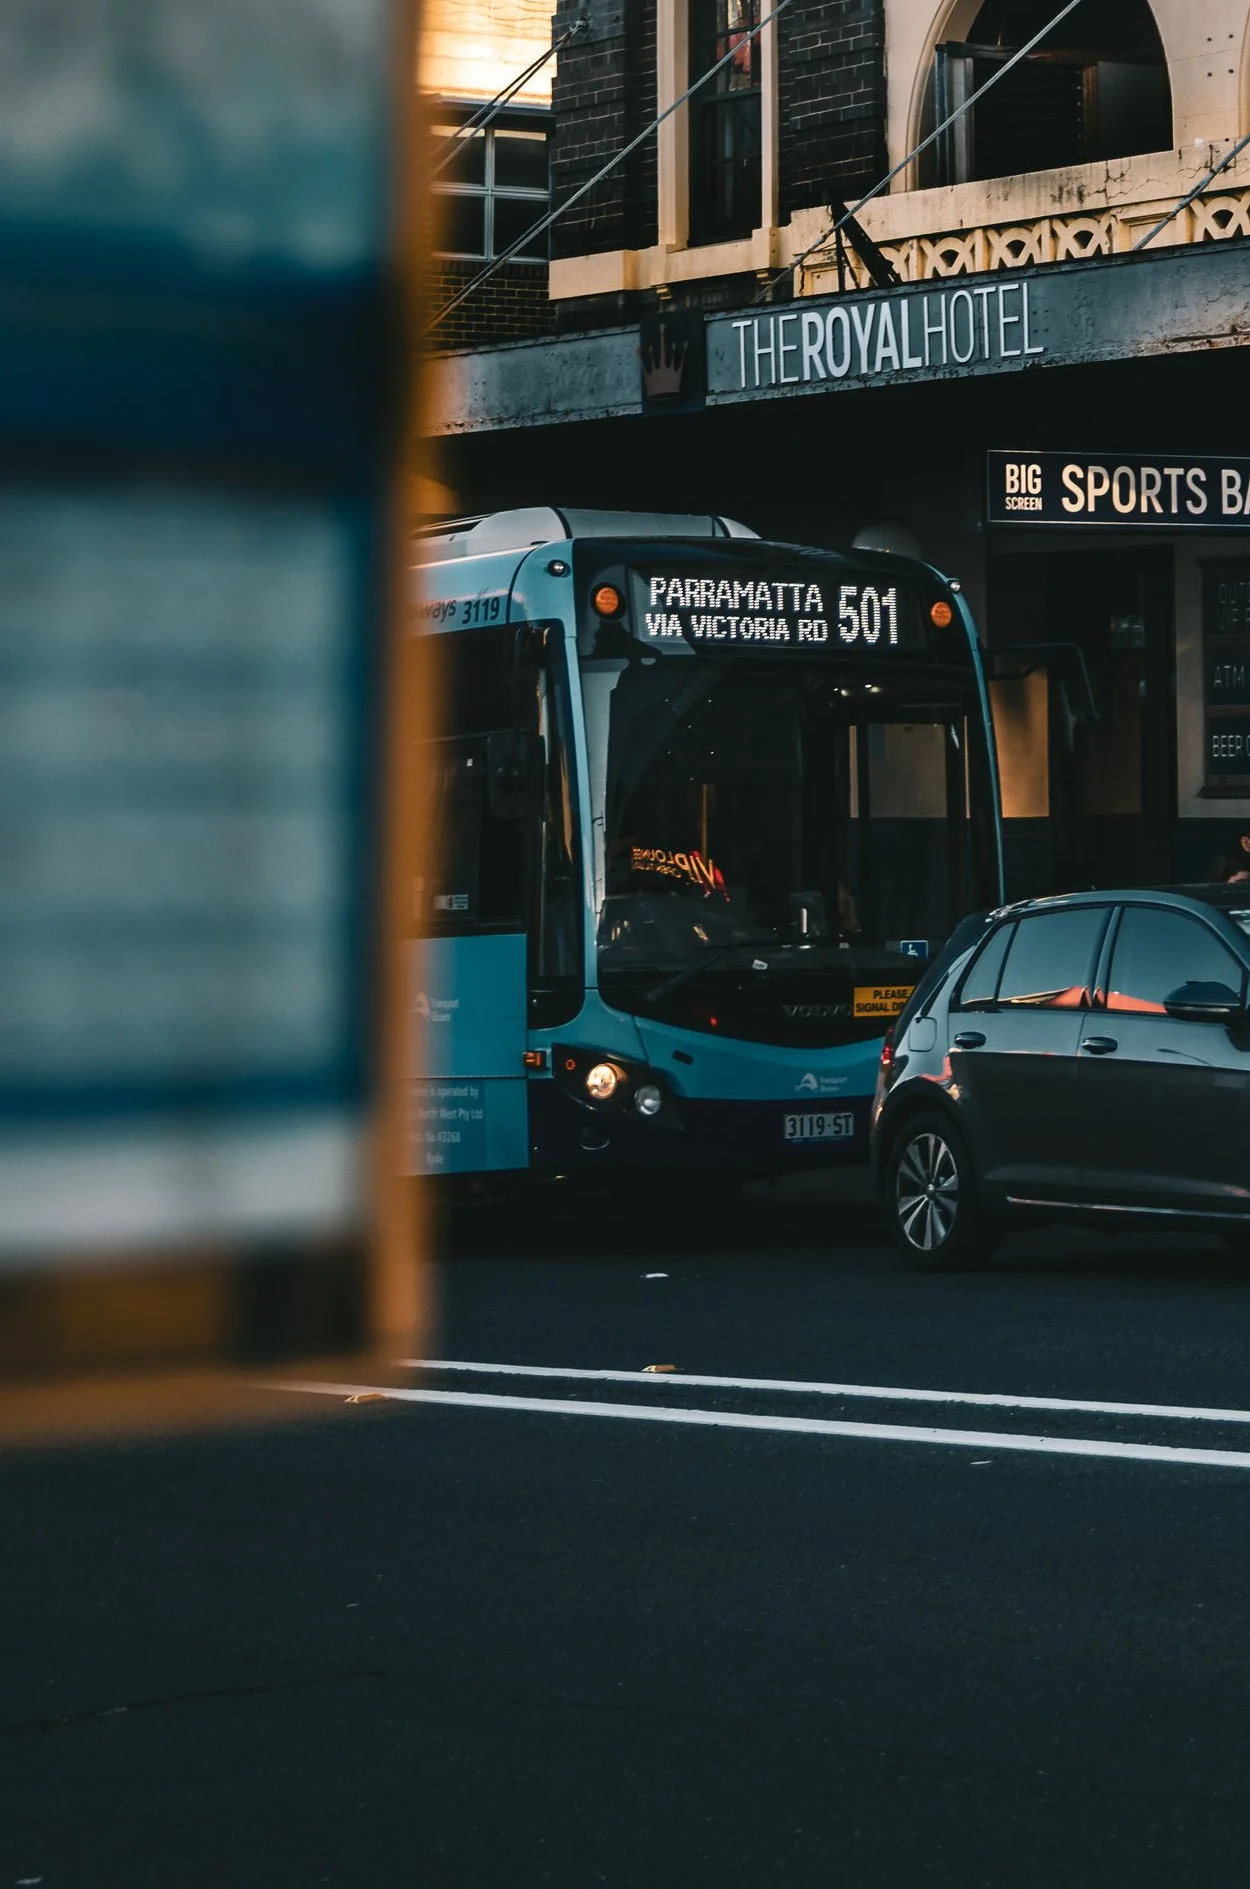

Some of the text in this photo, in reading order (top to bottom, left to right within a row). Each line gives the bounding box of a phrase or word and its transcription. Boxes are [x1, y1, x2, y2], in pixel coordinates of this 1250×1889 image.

[1005, 463, 1042, 494] BIG
[1061, 463, 1208, 517] SPORTS
[1005, 496, 1042, 511] SCREEN
[651, 577, 824, 612] PARRAMATTA
[462, 597, 500, 624] 3119
[838, 585, 898, 644] 501
[645, 613, 828, 642] VIA VICTORIA RD
[1213, 665, 1246, 688] ATM
[1212, 734, 1243, 758] BEER
[855, 1002, 890, 1013] SIGNAL
[873, 989, 909, 1000] PLEASE
